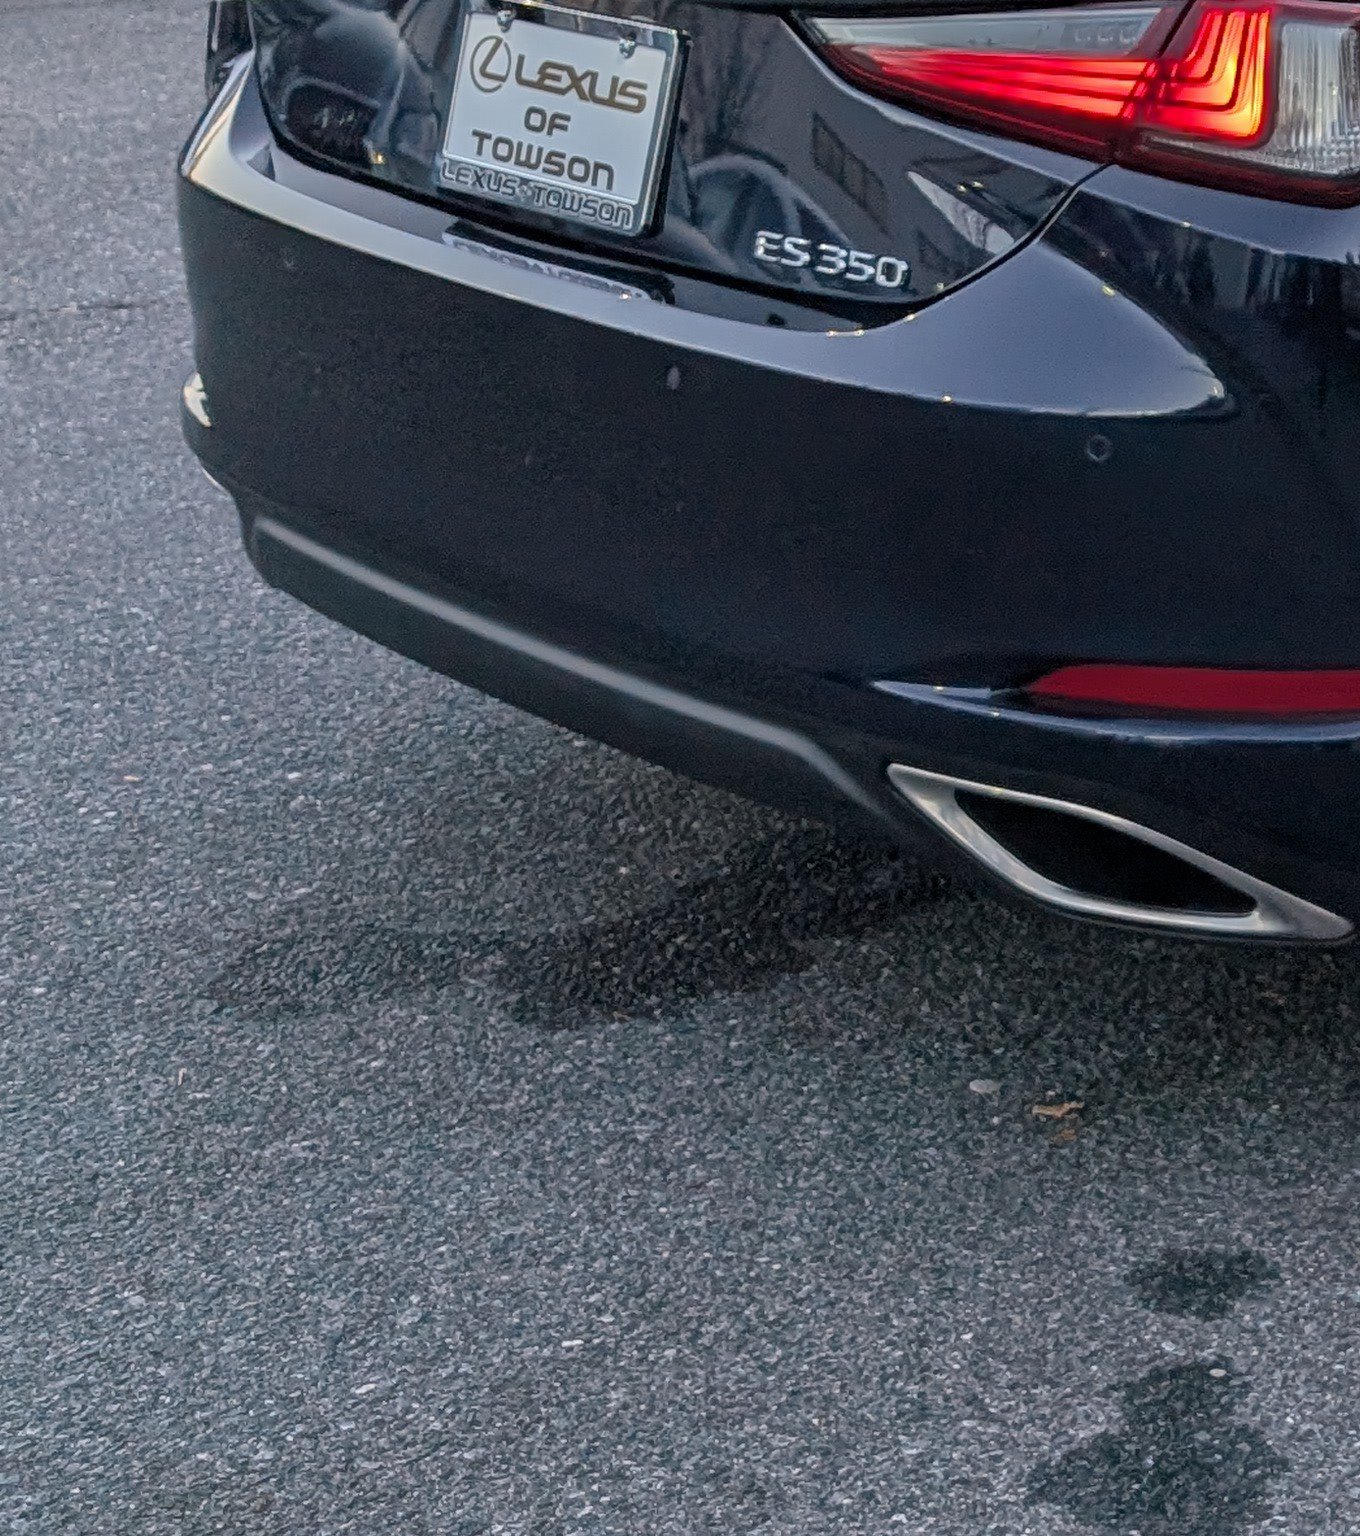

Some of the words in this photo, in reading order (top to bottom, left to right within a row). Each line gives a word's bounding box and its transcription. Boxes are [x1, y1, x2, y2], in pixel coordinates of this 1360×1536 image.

[515, 54, 648, 113] LEXUS
[524, 105, 571, 136] OF
[441, 160, 518, 197] LEXUS
[755, 230, 812, 267] ES
[815, 243, 908, 287] 350
